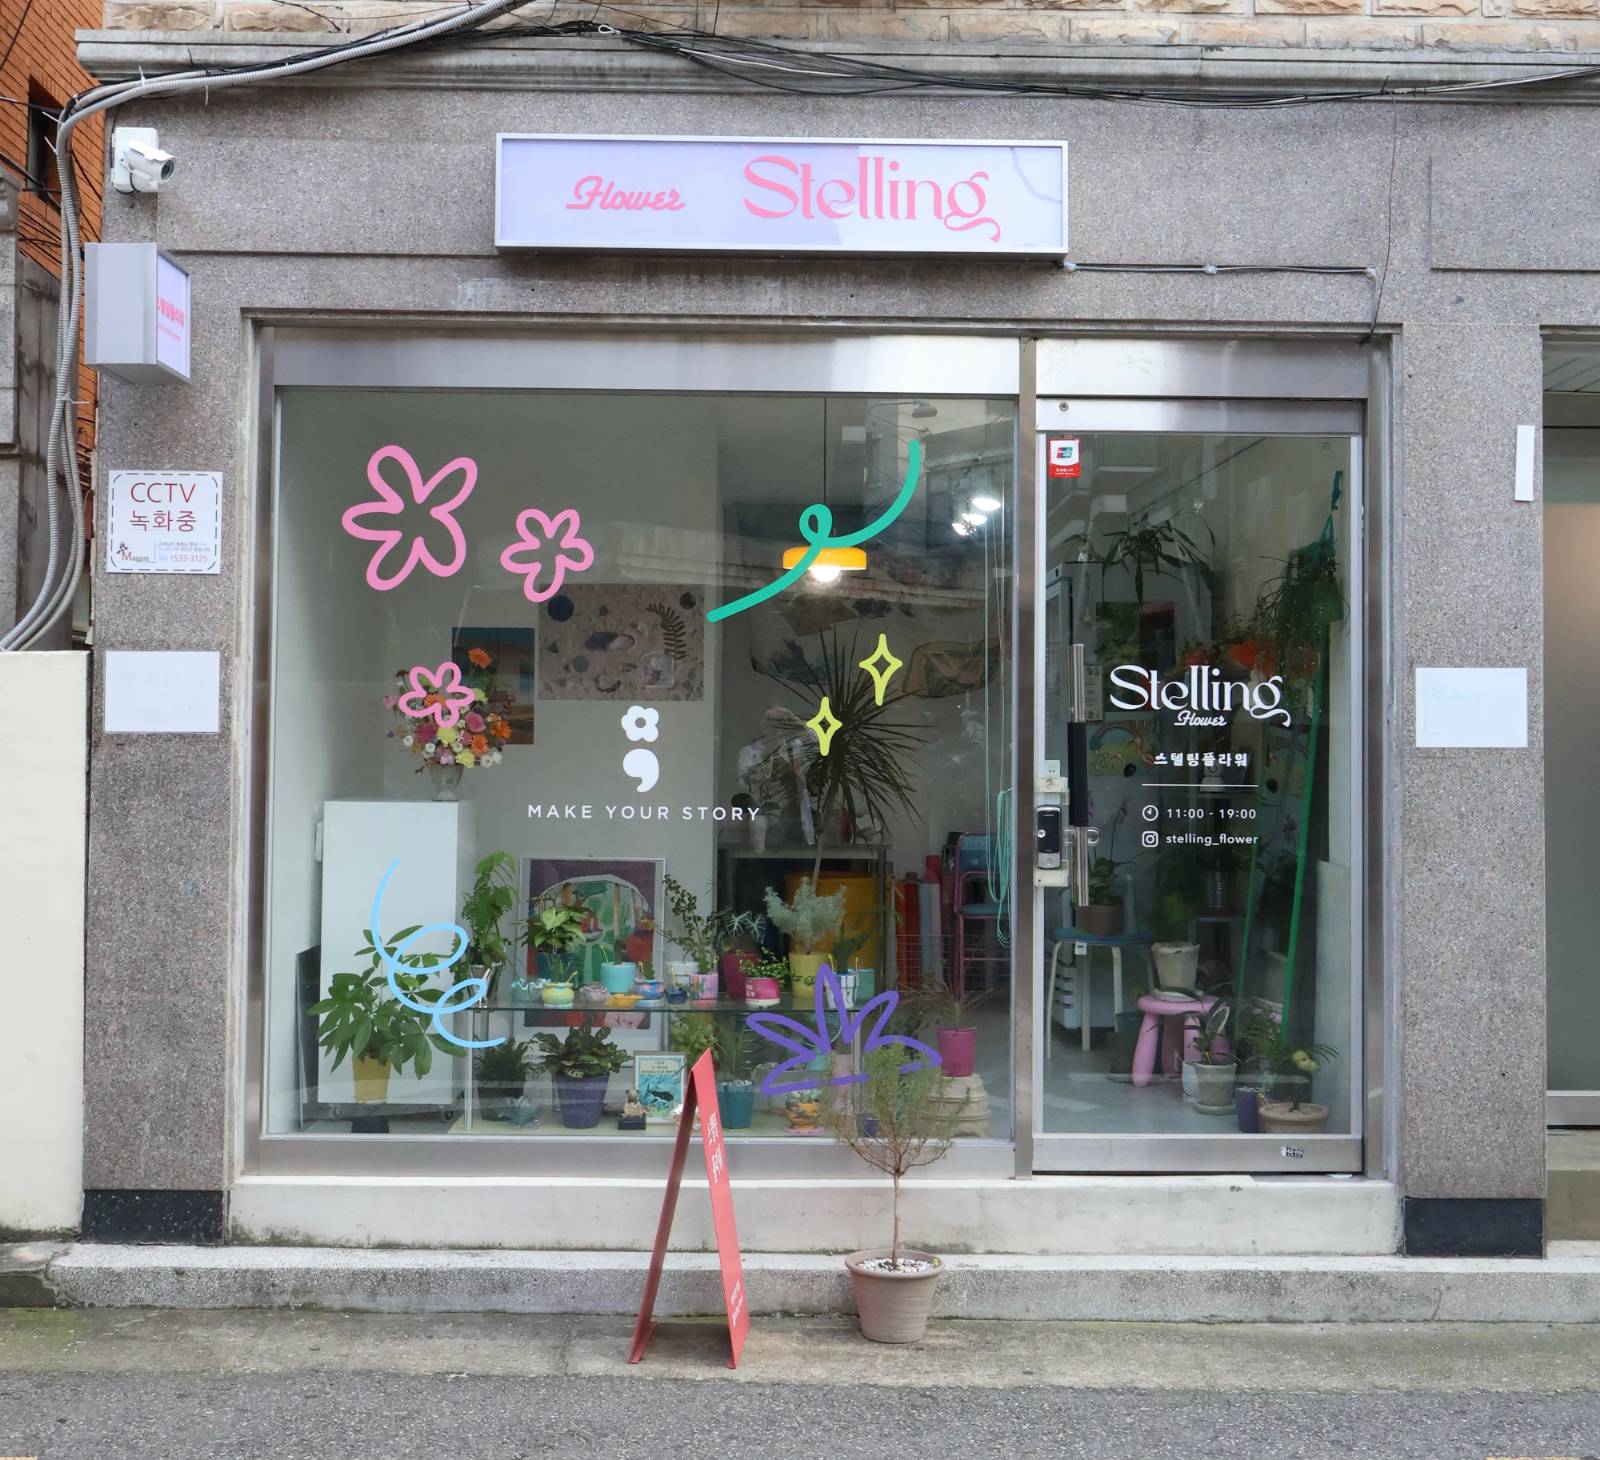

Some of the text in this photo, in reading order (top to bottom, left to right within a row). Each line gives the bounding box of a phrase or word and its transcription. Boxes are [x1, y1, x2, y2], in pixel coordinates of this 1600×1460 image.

[566, 155, 1001, 242] Flower Stelling
[130, 482, 196, 503] CCTV
[129, 510, 197, 533] 녹화중
[1110, 664, 1291, 728] Stelling
[1174, 710, 1228, 727] Flower
[1153, 752, 1248, 768] 스텔링플라워
[528, 804, 761, 821] MAKE YOUR STORY
[1167, 808, 1204, 820] 11:00
[1218, 808, 1257, 820] 19:00
[1166, 833, 1259, 847] stelling_flower
